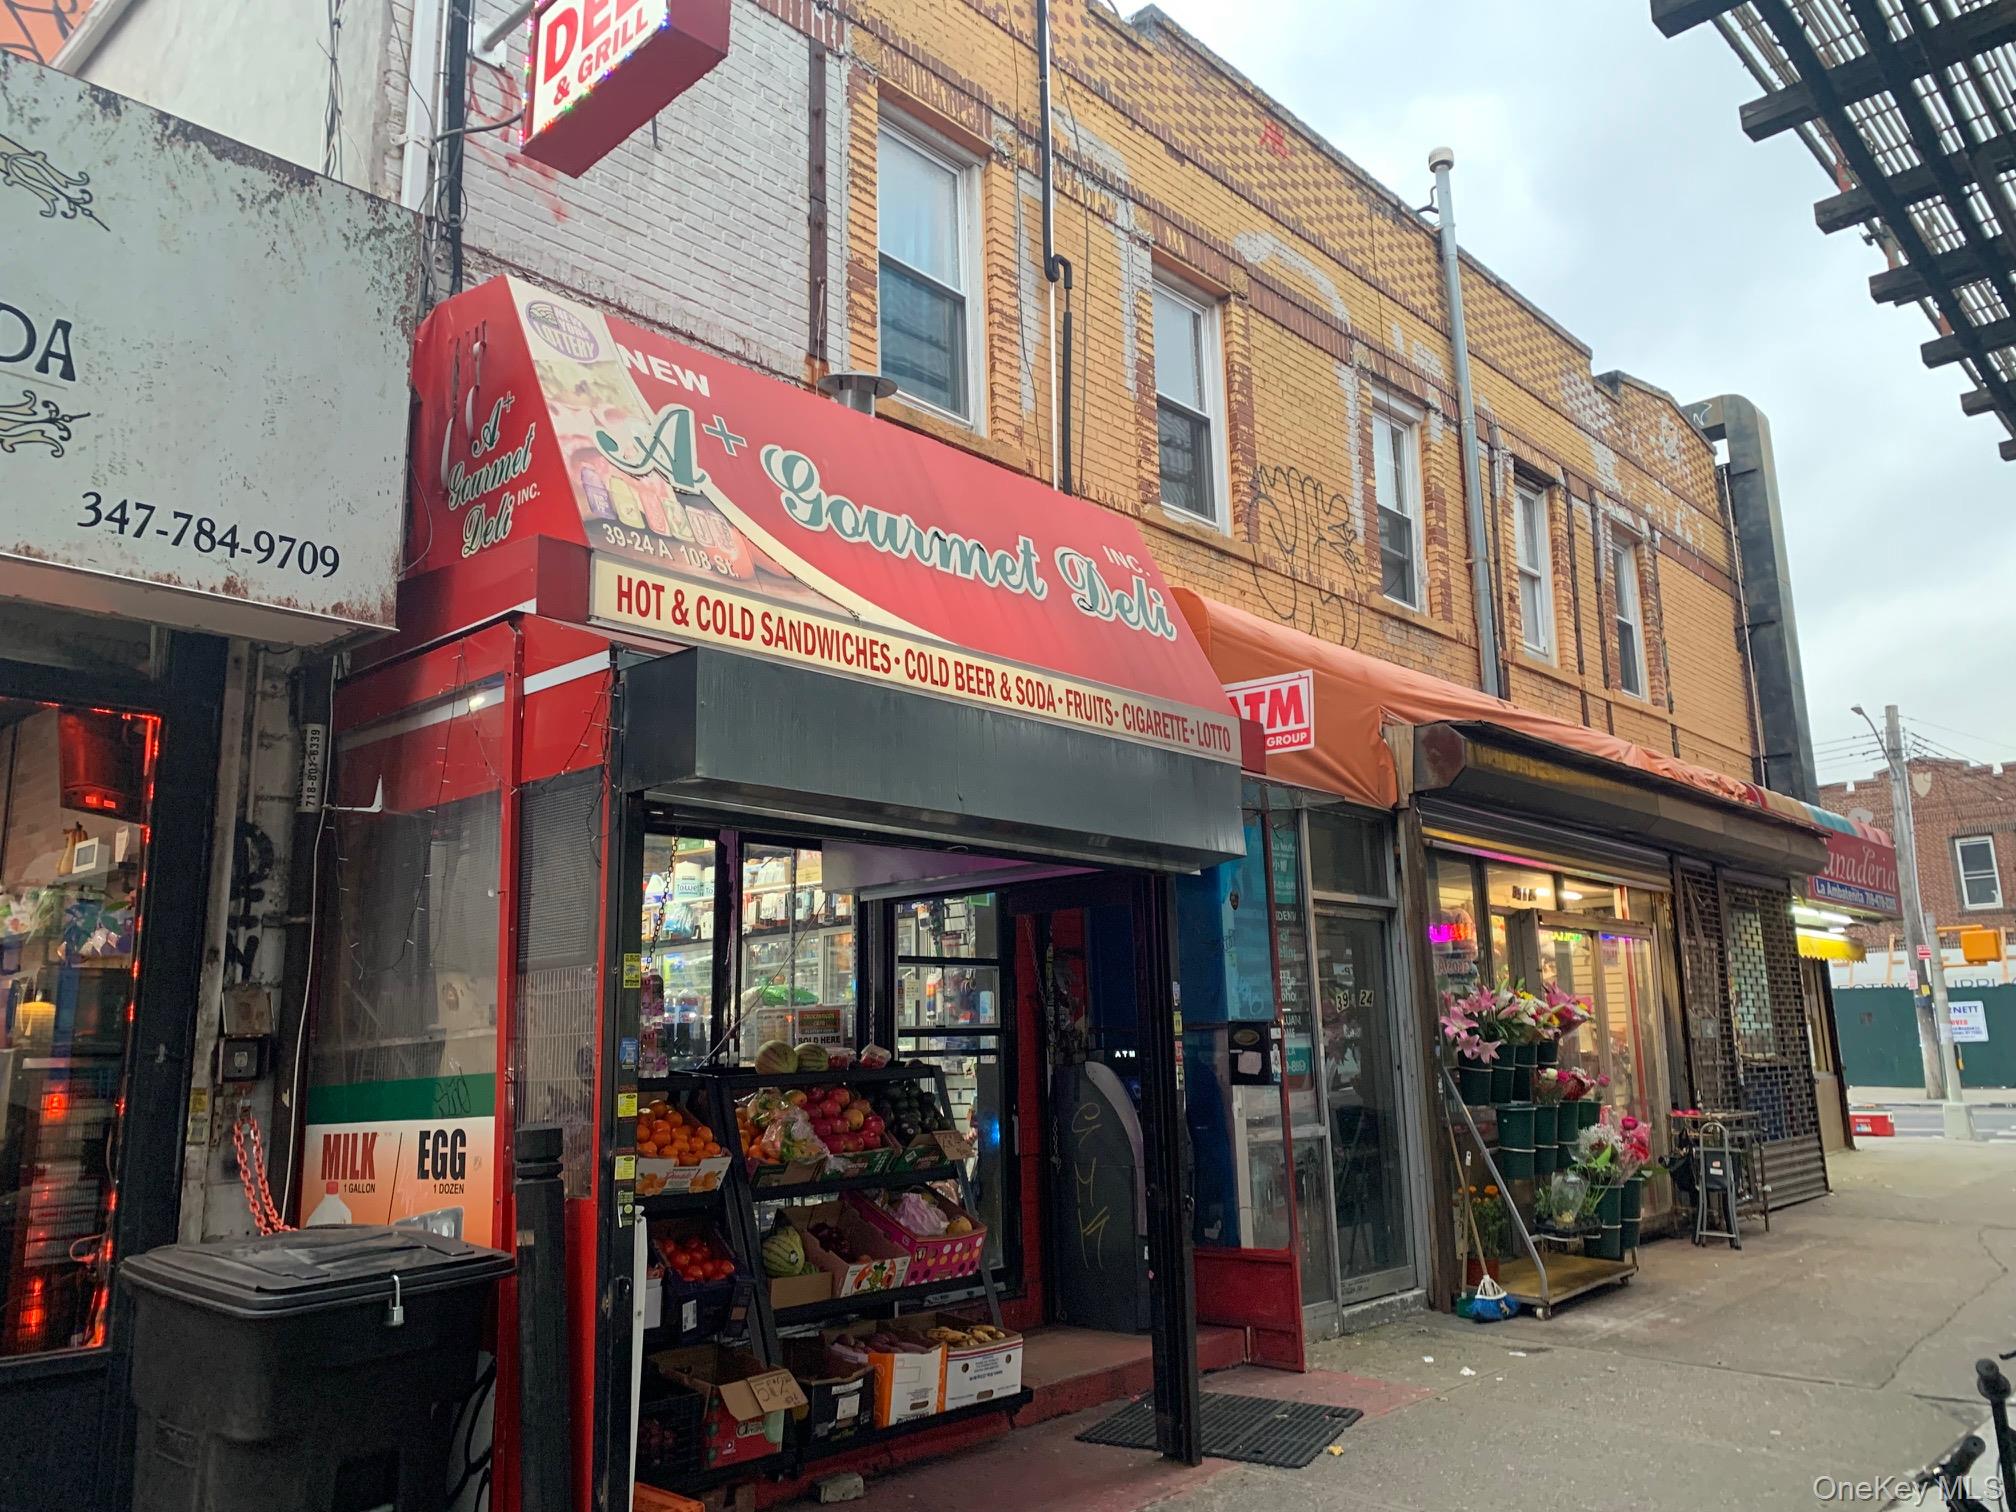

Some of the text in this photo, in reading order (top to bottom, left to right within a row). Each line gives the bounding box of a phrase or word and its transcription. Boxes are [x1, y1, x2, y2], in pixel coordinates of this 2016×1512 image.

[554, 8, 648, 106] & GRILL
[616, 343, 711, 397] NEW
[448, 421, 537, 511] Gourmet
[77, 491, 340, 578] 347-784-9709
[461, 482, 541, 559] Deli INC.
[760, 444, 1048, 600] Gourmet
[1054, 546, 1177, 641] Deli
[602, 523, 741, 579] 39-24 A 108 St.
[1102, 543, 1151, 577] INC.
[616, 574, 1231, 753] HOT & COLD SANDWICHES COLD BEER & SODA FRUITS CIGARETTE LOTTO
[1229, 684, 1305, 729] TM
[1266, 731, 1307, 747] GROUP
[1336, 990, 1373, 1011] 39 24
[820, 1035, 841, 1044] HERE
[1114, 1050, 1136, 1058] ATM
[321, 1128, 466, 1180] MILK EGG
[348, 1182, 376, 1194] GALLON
[438, 1183, 465, 1194] DOZEN
